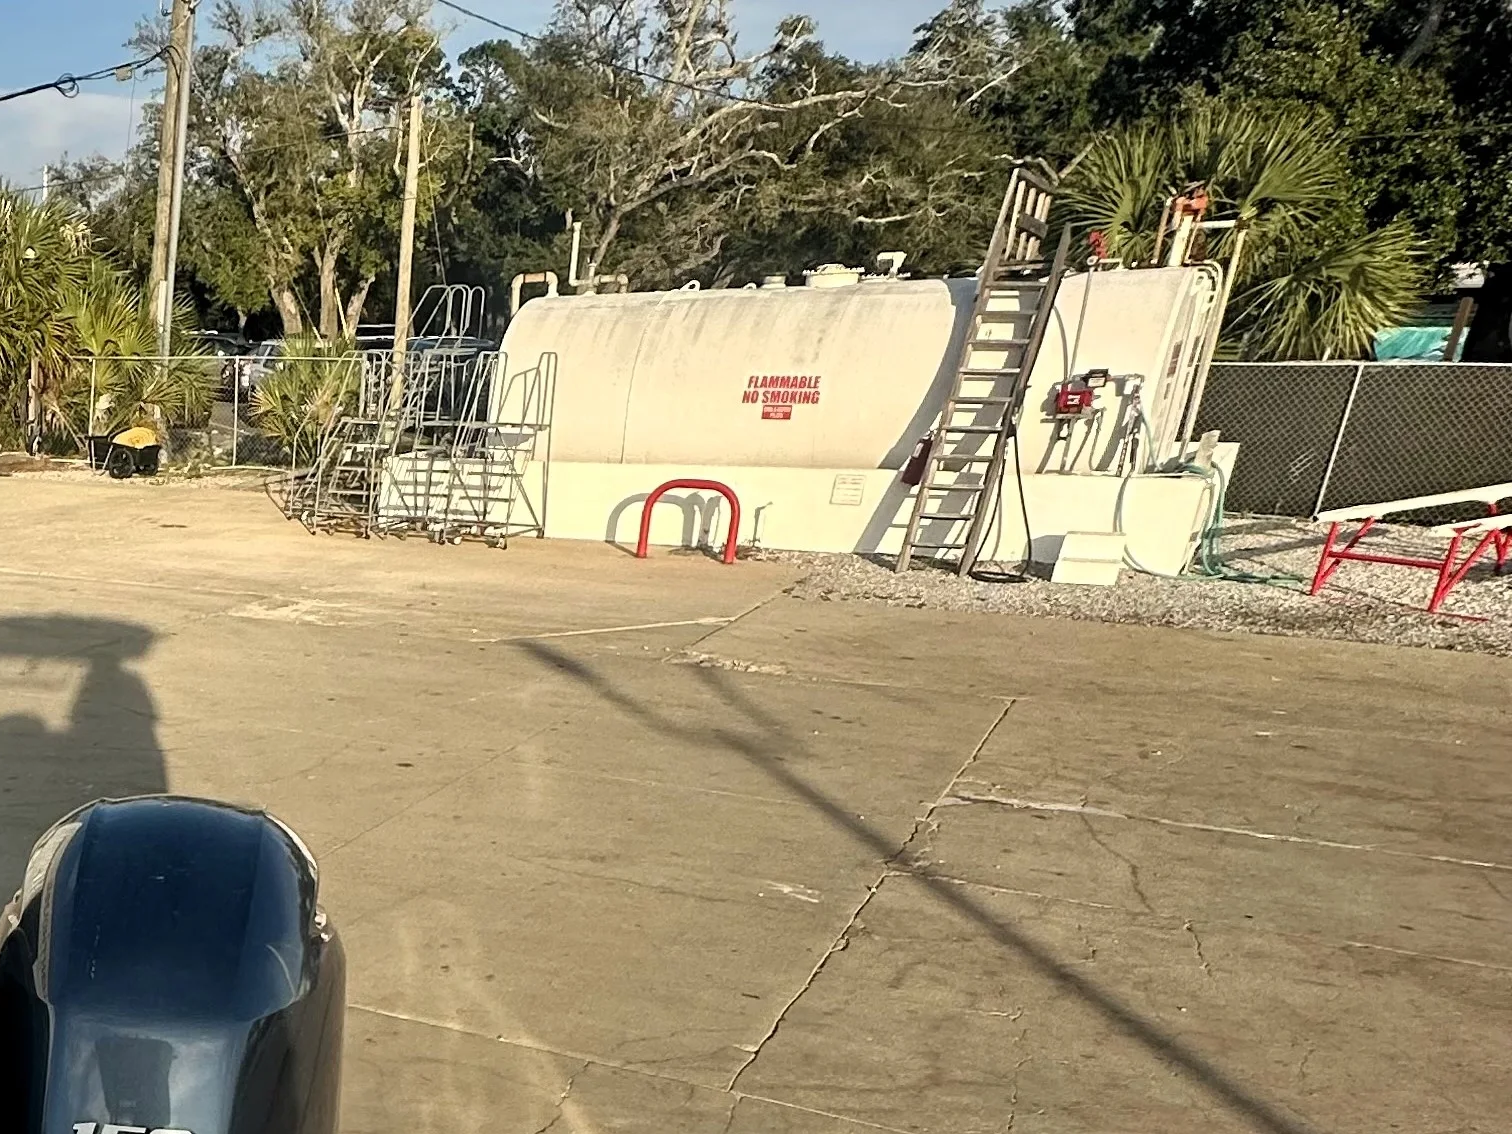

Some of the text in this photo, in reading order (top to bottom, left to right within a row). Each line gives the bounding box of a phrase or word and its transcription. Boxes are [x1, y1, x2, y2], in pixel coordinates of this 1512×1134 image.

[747, 375, 822, 389] FLAMMABLE
[742, 390, 821, 404] NO SMOKING
